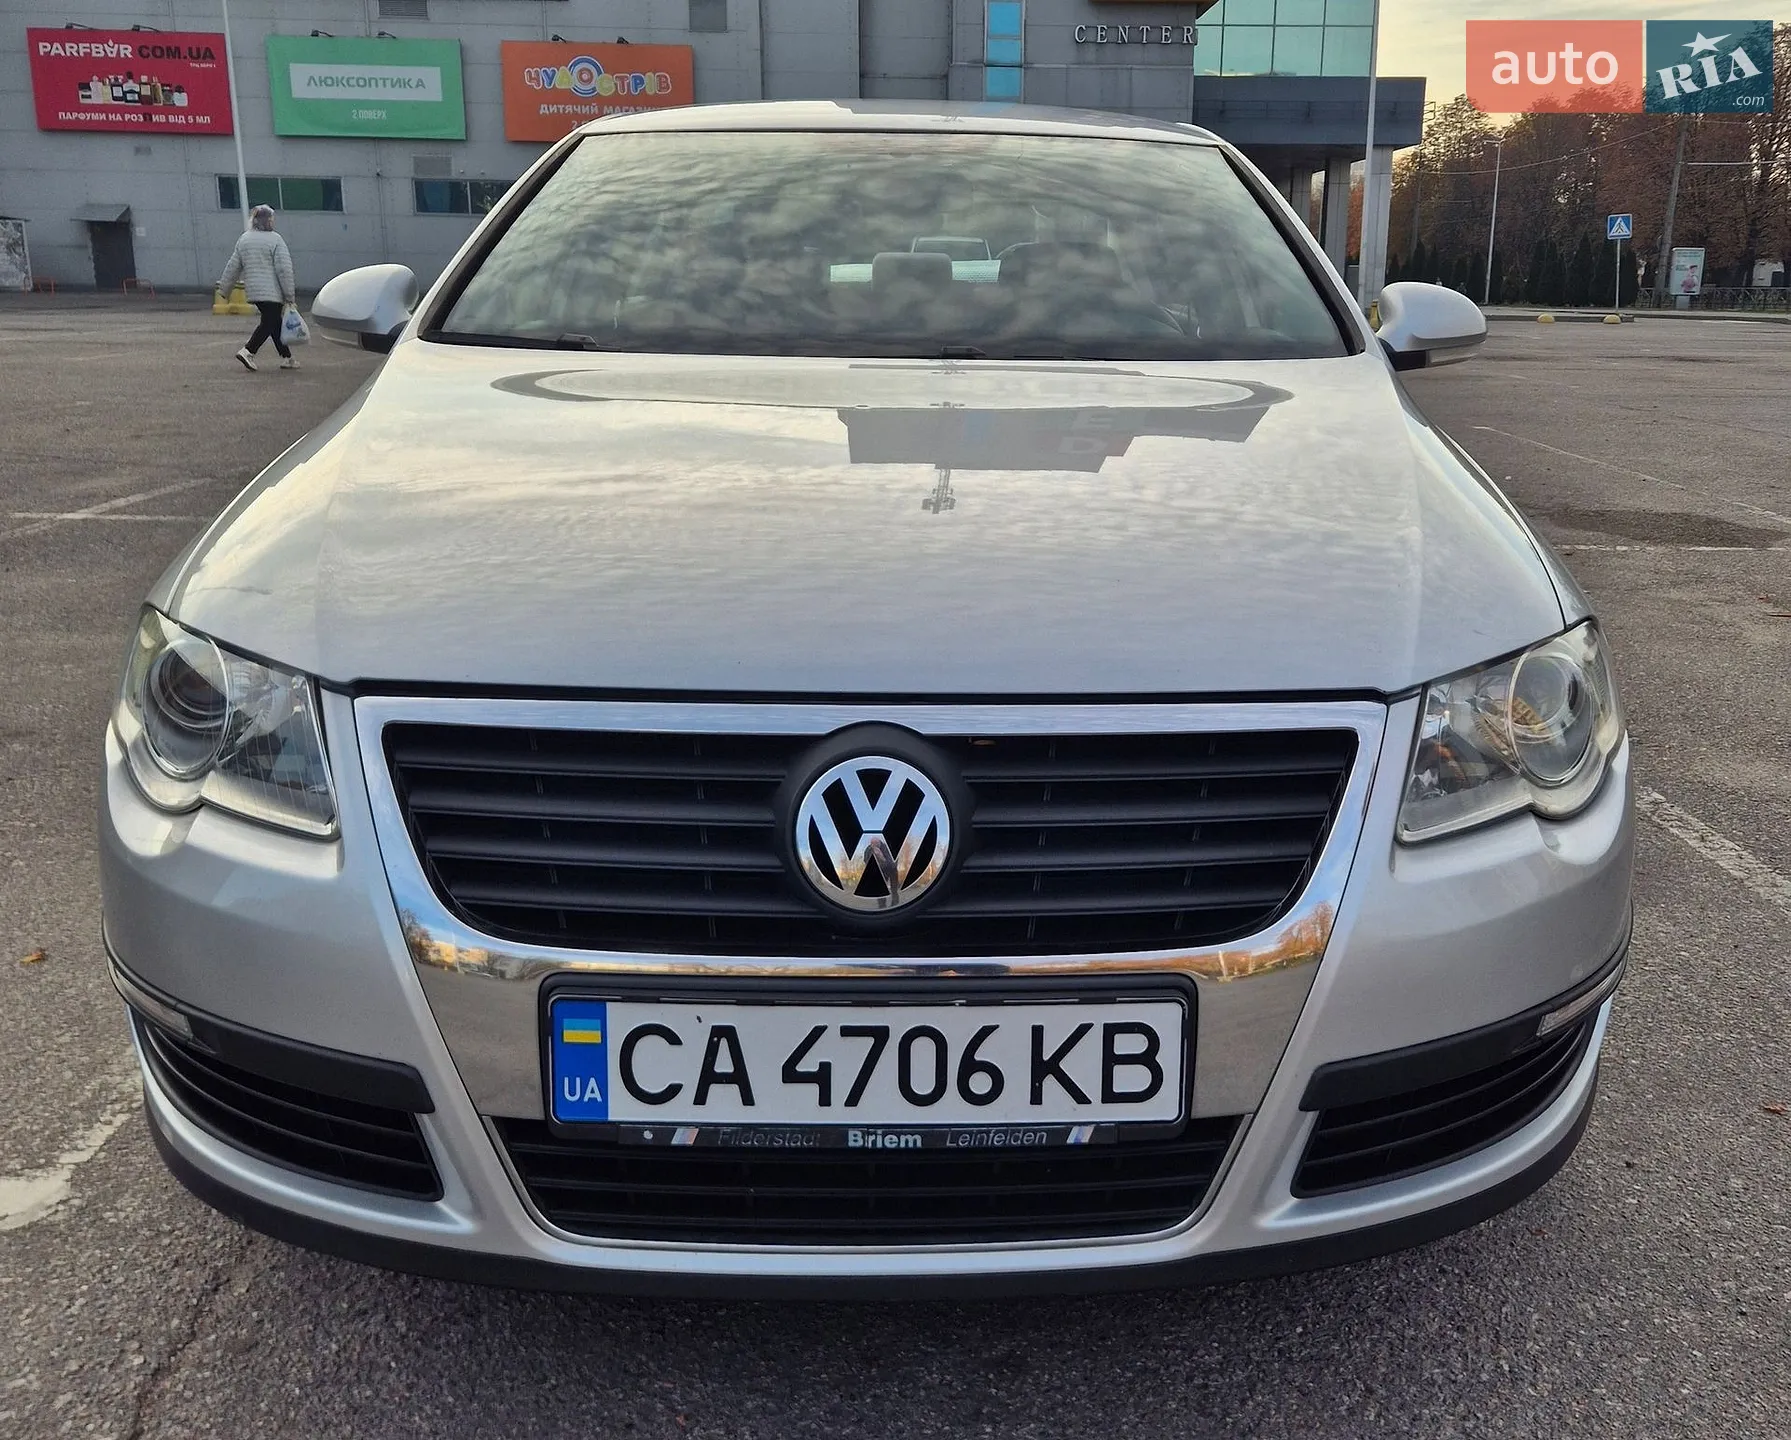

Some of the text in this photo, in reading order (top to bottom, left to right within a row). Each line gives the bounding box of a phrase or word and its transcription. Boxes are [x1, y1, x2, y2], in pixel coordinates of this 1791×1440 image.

[1074, 24, 1194, 44] CENTER
[38, 39, 216, 61] PARFBAR COM.UA
[306, 75, 426, 89] ЛЮКСОПТИКА
[58, 111, 107, 121] ПАРФУМИ
[108, 112, 123, 121] НА
[168, 114, 186, 124] ВІД
[187, 115, 194, 124] 5
[195, 116, 211, 124] МЛ
[352, 109, 387, 120] 2 ПОВЕРХ
[539, 103, 599, 115] ДИТЯЧИЙ
[619, 1021, 1164, 1107] CA 4706 KB
[563, 1077, 603, 1102] UA
[848, 1129, 922, 1149] Briem
[946, 1128, 1047, 1147] Leinfelden
